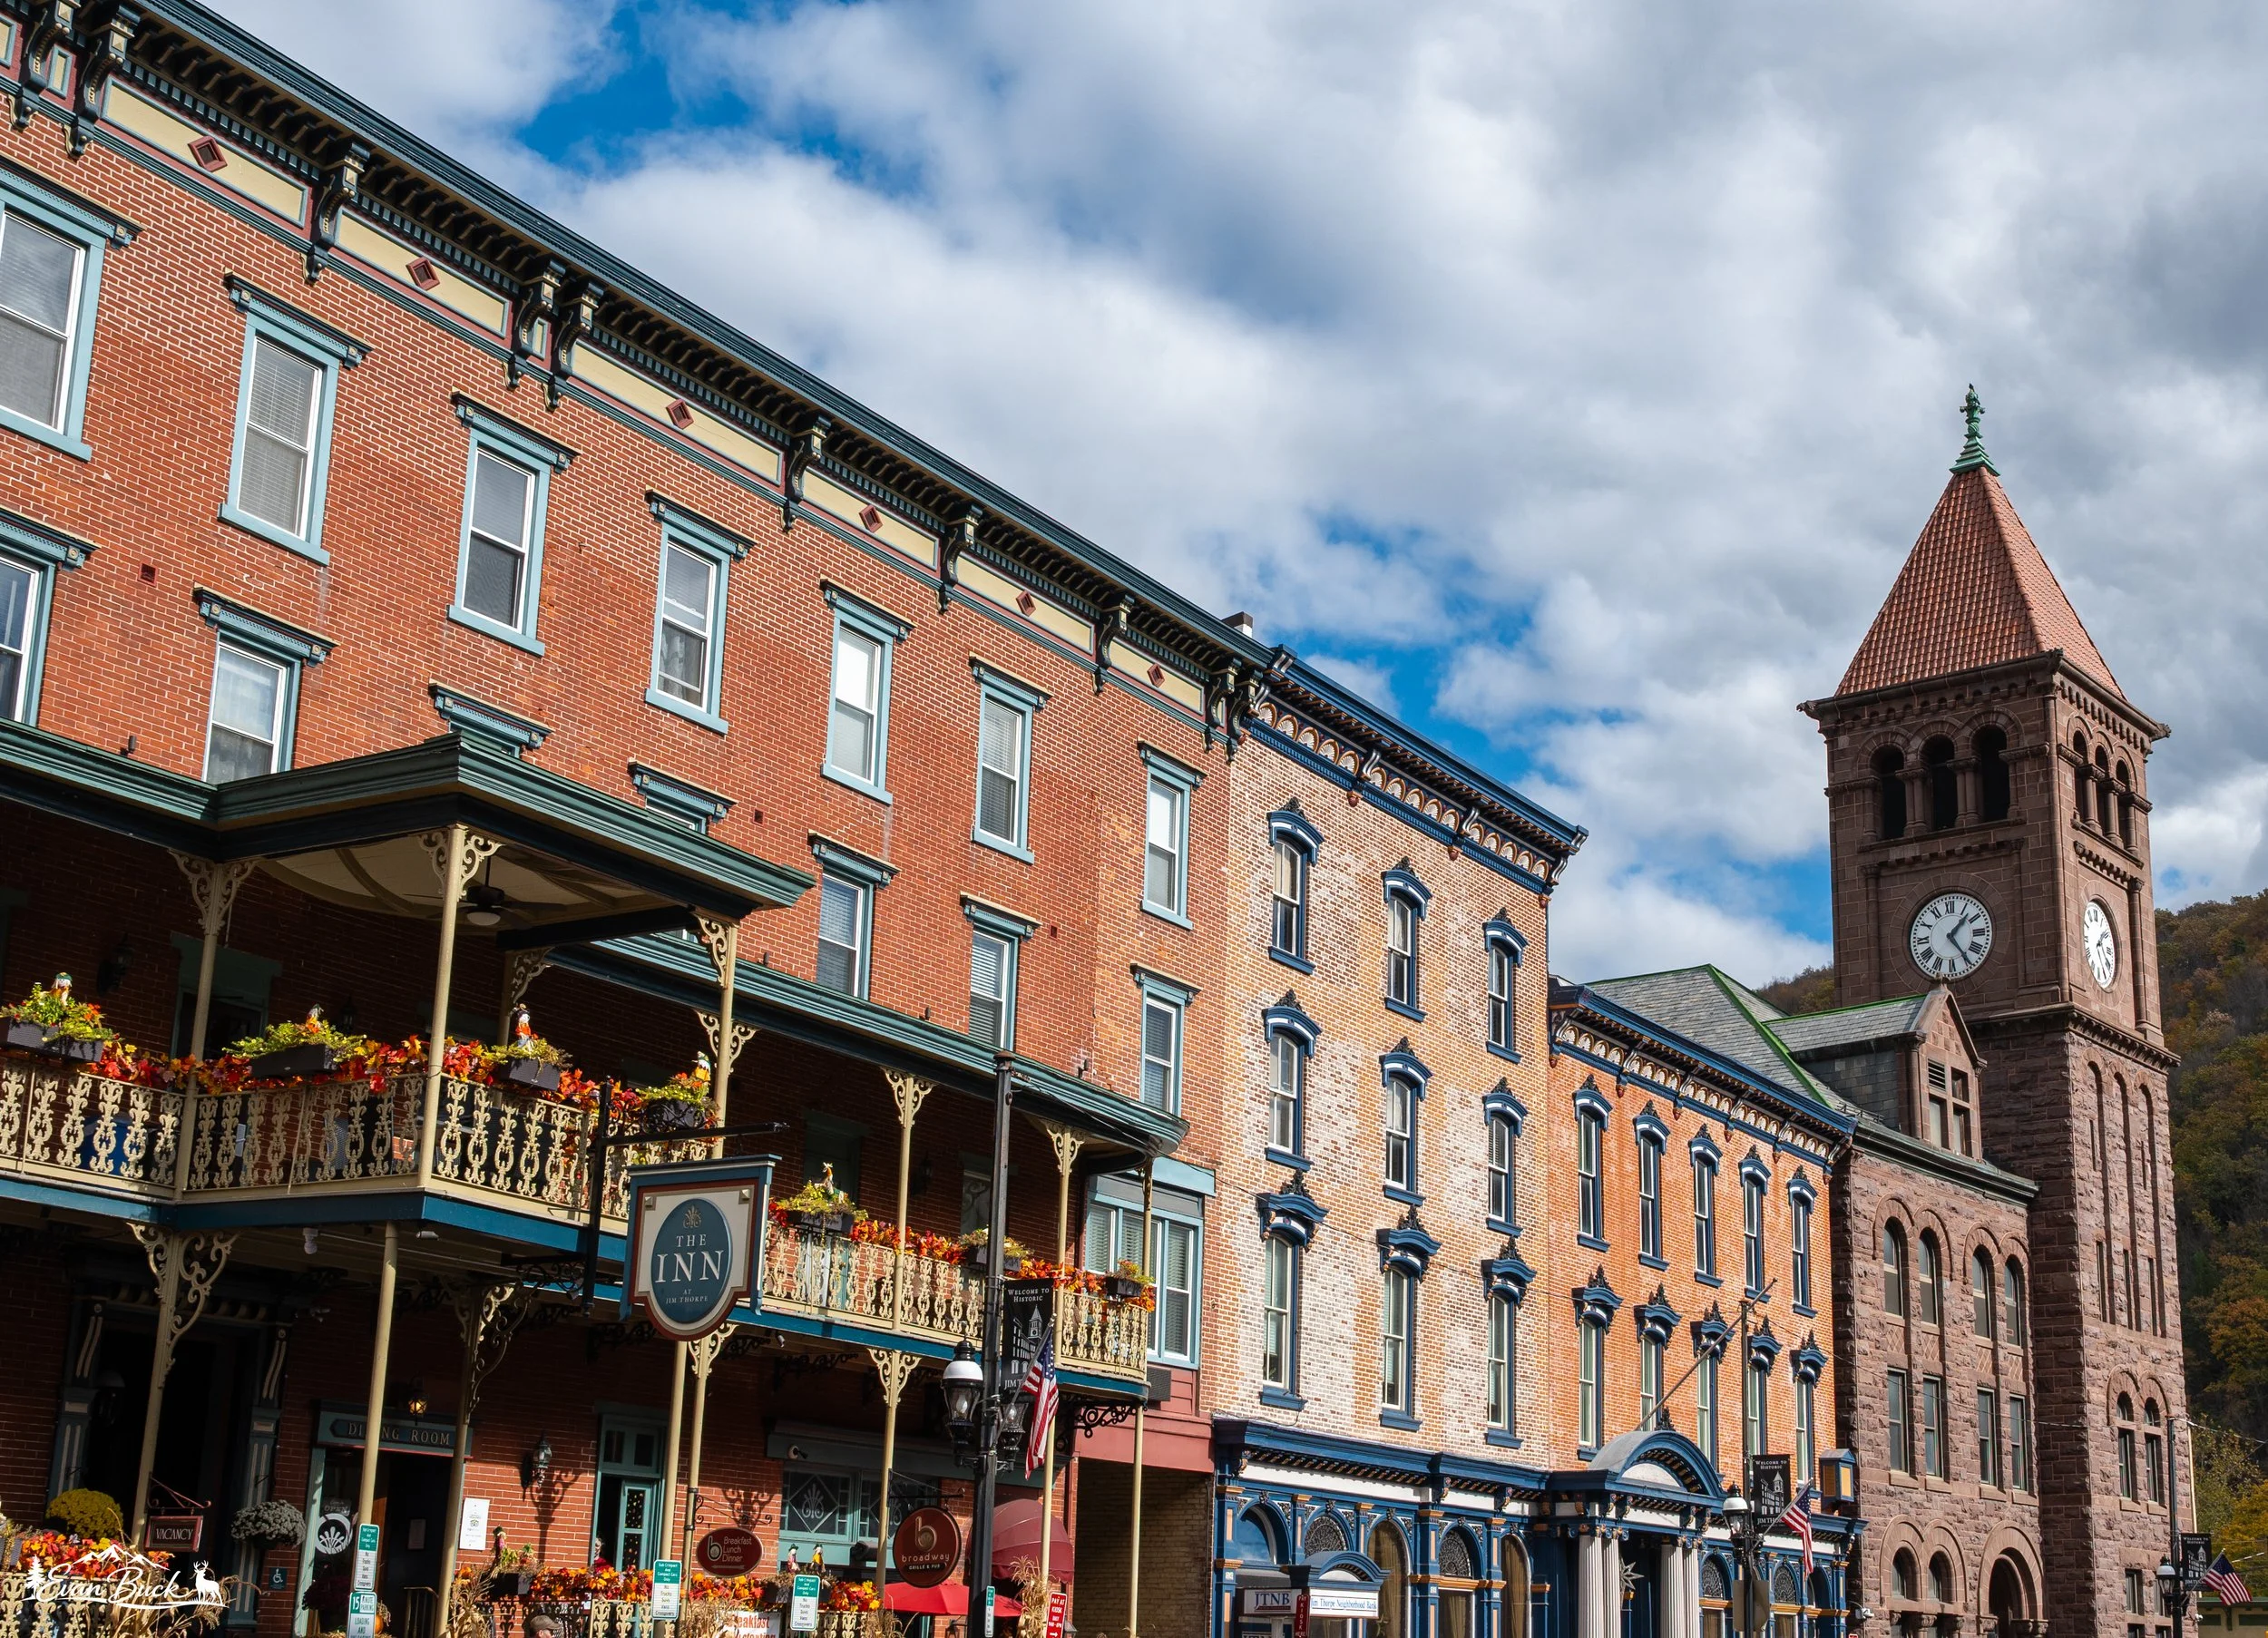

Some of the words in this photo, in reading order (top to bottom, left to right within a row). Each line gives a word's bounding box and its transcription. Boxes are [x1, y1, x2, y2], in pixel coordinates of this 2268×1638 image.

[676, 1233, 707, 1248] THE
[654, 1250, 724, 1283] INN
[1008, 1288, 1039, 1296] WELCOME
[679, 1295, 709, 1303] THORPE
[1003, 1379, 1017, 1389] JIM
[348, 1422, 399, 1440] DING
[411, 1429, 451, 1446] ROOM
[156, 1527, 193, 1540] VACANCY
[723, 1536, 752, 1545] Breakfast
[723, 1545, 742, 1554] Lunch
[722, 1554, 743, 1562] Dinner
[902, 1553, 950, 1563] broadway
[352, 1596, 360, 1610] 15
[1255, 1593, 1290, 1608] JTNB
[1320, 1598, 1335, 1608] Thorpe
[1336, 1599, 1365, 1609] Neighborhood
[1366, 1601, 1377, 1610] Bank
[355, 1617, 370, 1625] LOADING
[357, 1626, 366, 1634] AND
